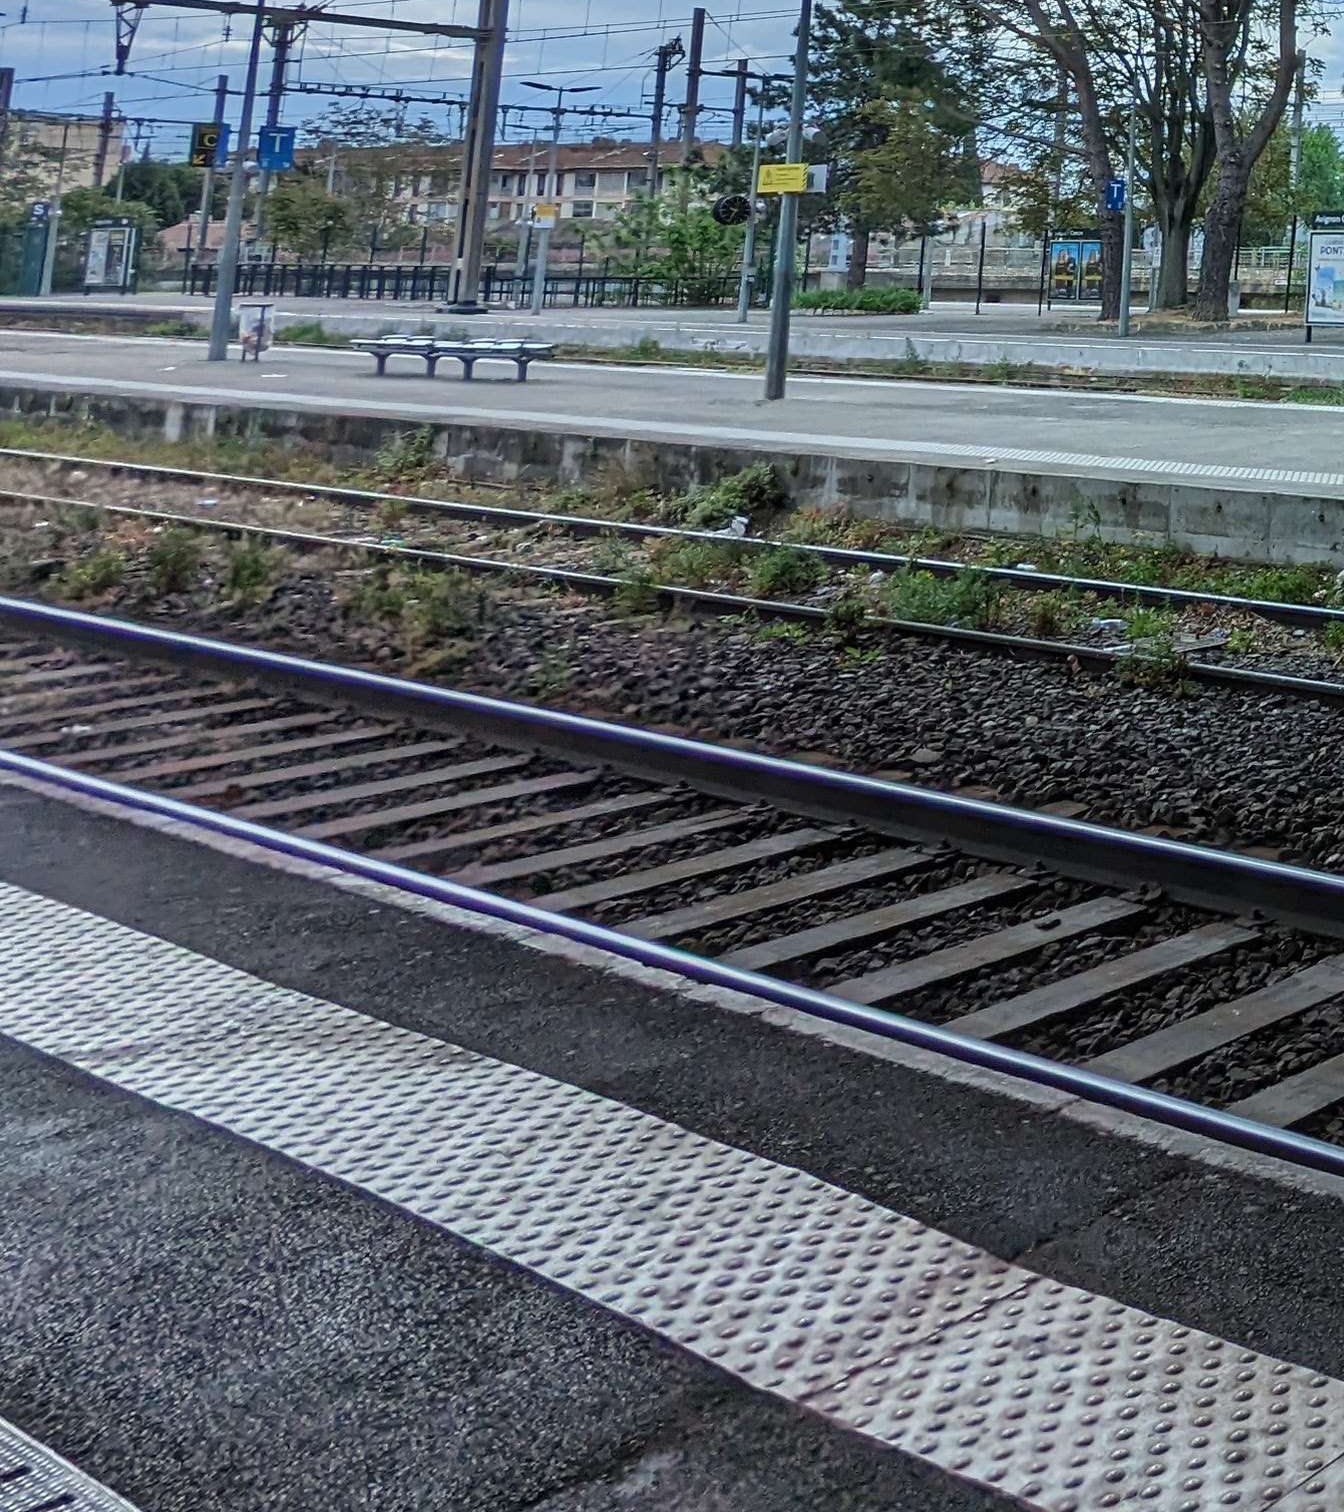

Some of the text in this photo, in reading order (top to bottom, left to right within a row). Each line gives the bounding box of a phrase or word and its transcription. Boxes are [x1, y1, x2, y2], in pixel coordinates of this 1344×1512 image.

[268, 133, 289, 153] T
[1110, 184, 1122, 198] T
[33, 204, 44, 215] S
[1315, 215, 1341, 225] Avignon
